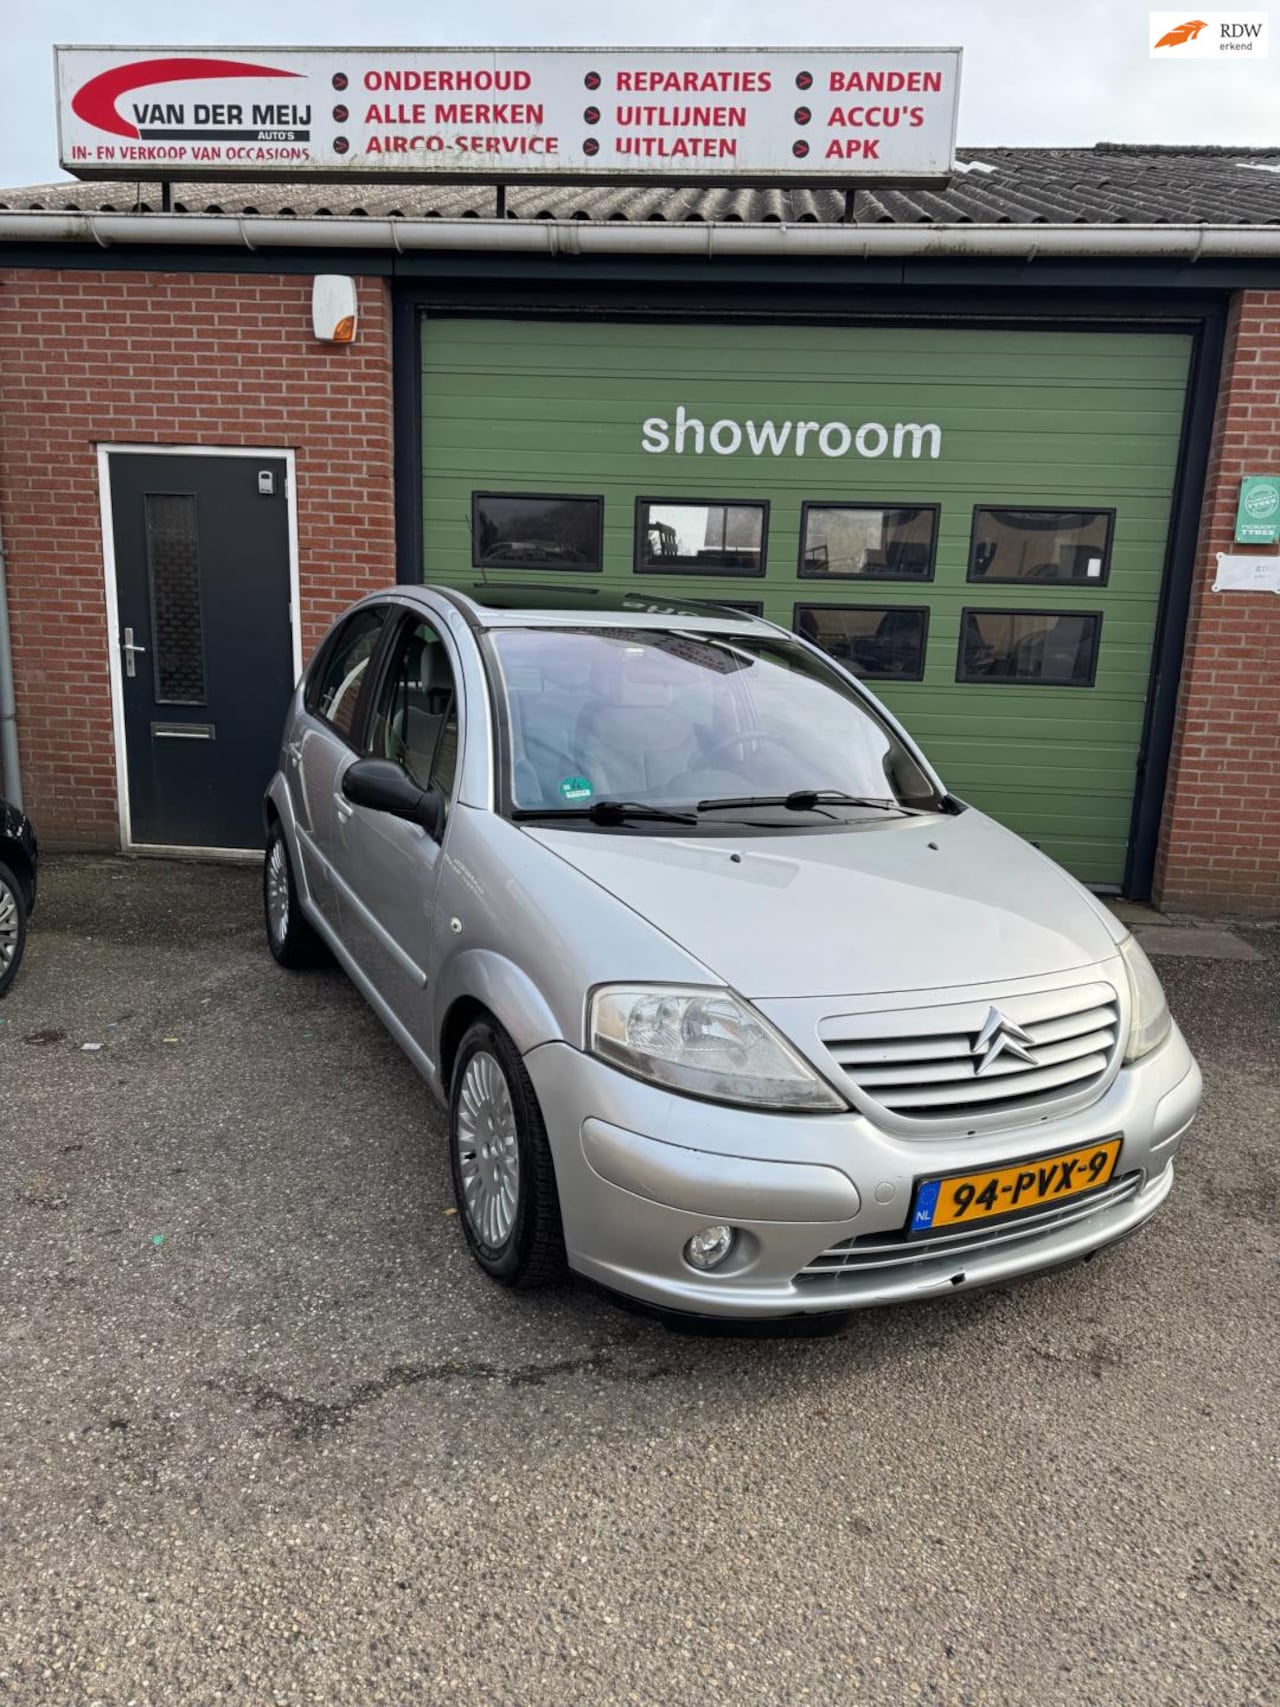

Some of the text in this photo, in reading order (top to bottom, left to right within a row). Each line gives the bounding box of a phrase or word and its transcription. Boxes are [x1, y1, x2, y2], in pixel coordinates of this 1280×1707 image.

[363, 70, 532, 91] ONDERHOUD
[616, 71, 772, 92] REPARATIES
[828, 71, 942, 93] BANDEN
[132, 104, 312, 126] VAN DER MEIJ
[364, 103, 544, 124] ALLE MERKEN
[616, 106, 747, 127] UITLIJNEN
[827, 105, 925, 127] ACCU'S
[257, 130, 295, 141] AUTO'S
[365, 136, 560, 155] AIRCO-SERVICE
[71, 145, 311, 161] IN- EN VERKOOP VAN OCCASIONS
[615, 137, 738, 158] UITLATEN
[825, 138, 881, 160] APK
[641, 406, 942, 459] showroom
[952, 1150, 1109, 1218] 94-PVX-9
[915, 1211, 931, 1221] NL
